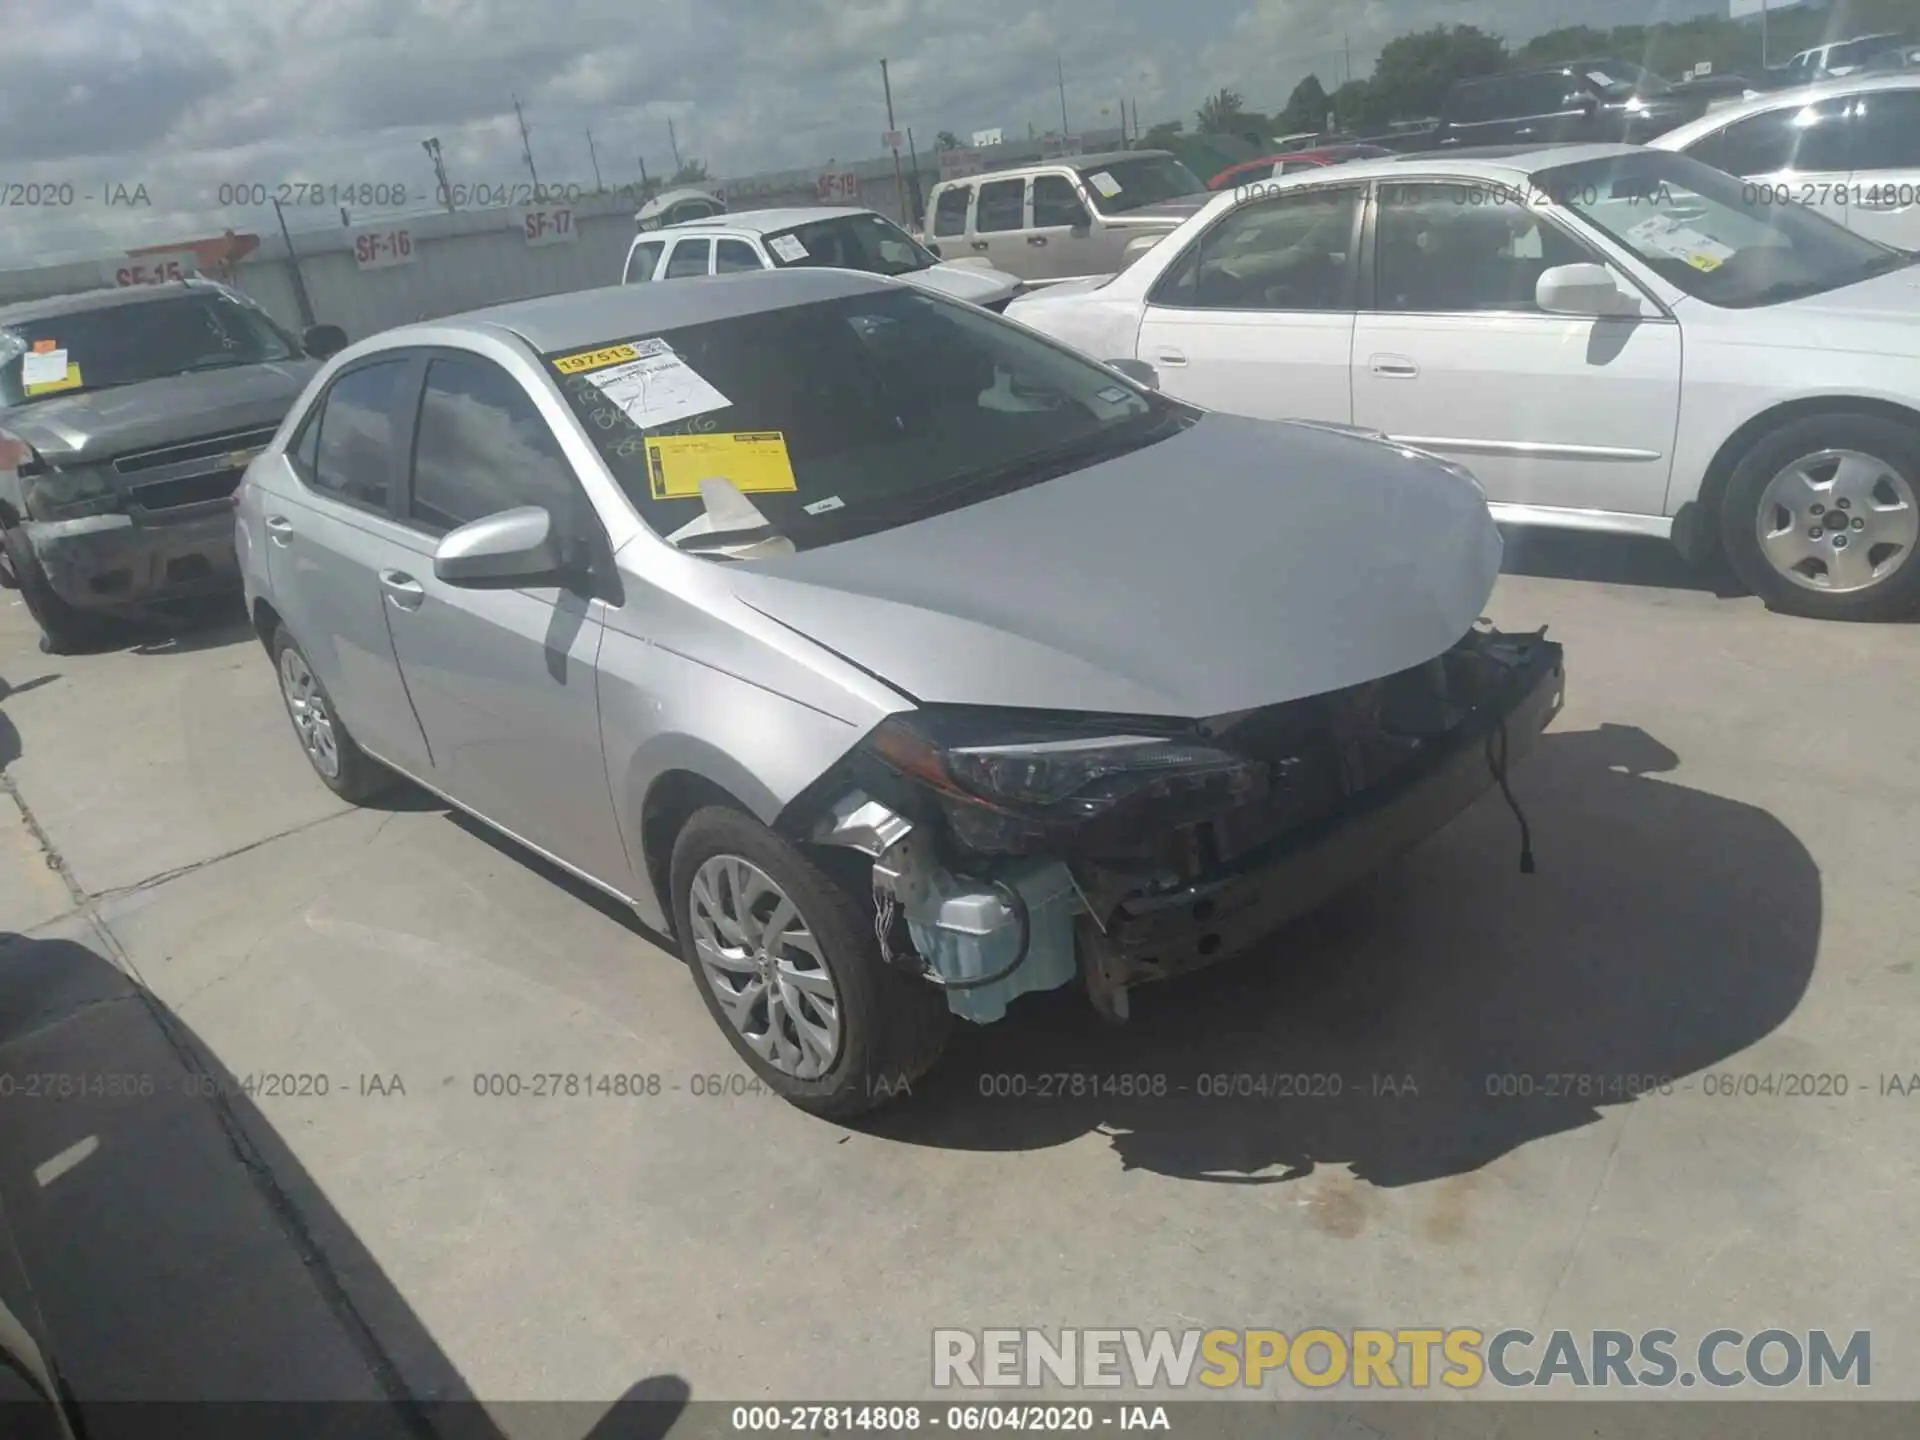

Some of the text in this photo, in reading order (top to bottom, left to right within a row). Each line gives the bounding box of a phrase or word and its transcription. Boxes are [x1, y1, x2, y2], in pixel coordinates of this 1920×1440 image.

[525, 210, 571, 239] SF-17
[356, 231, 411, 263] SF-16
[116, 262, 182, 287] SF-15
[558, 346, 636, 370] 197513
